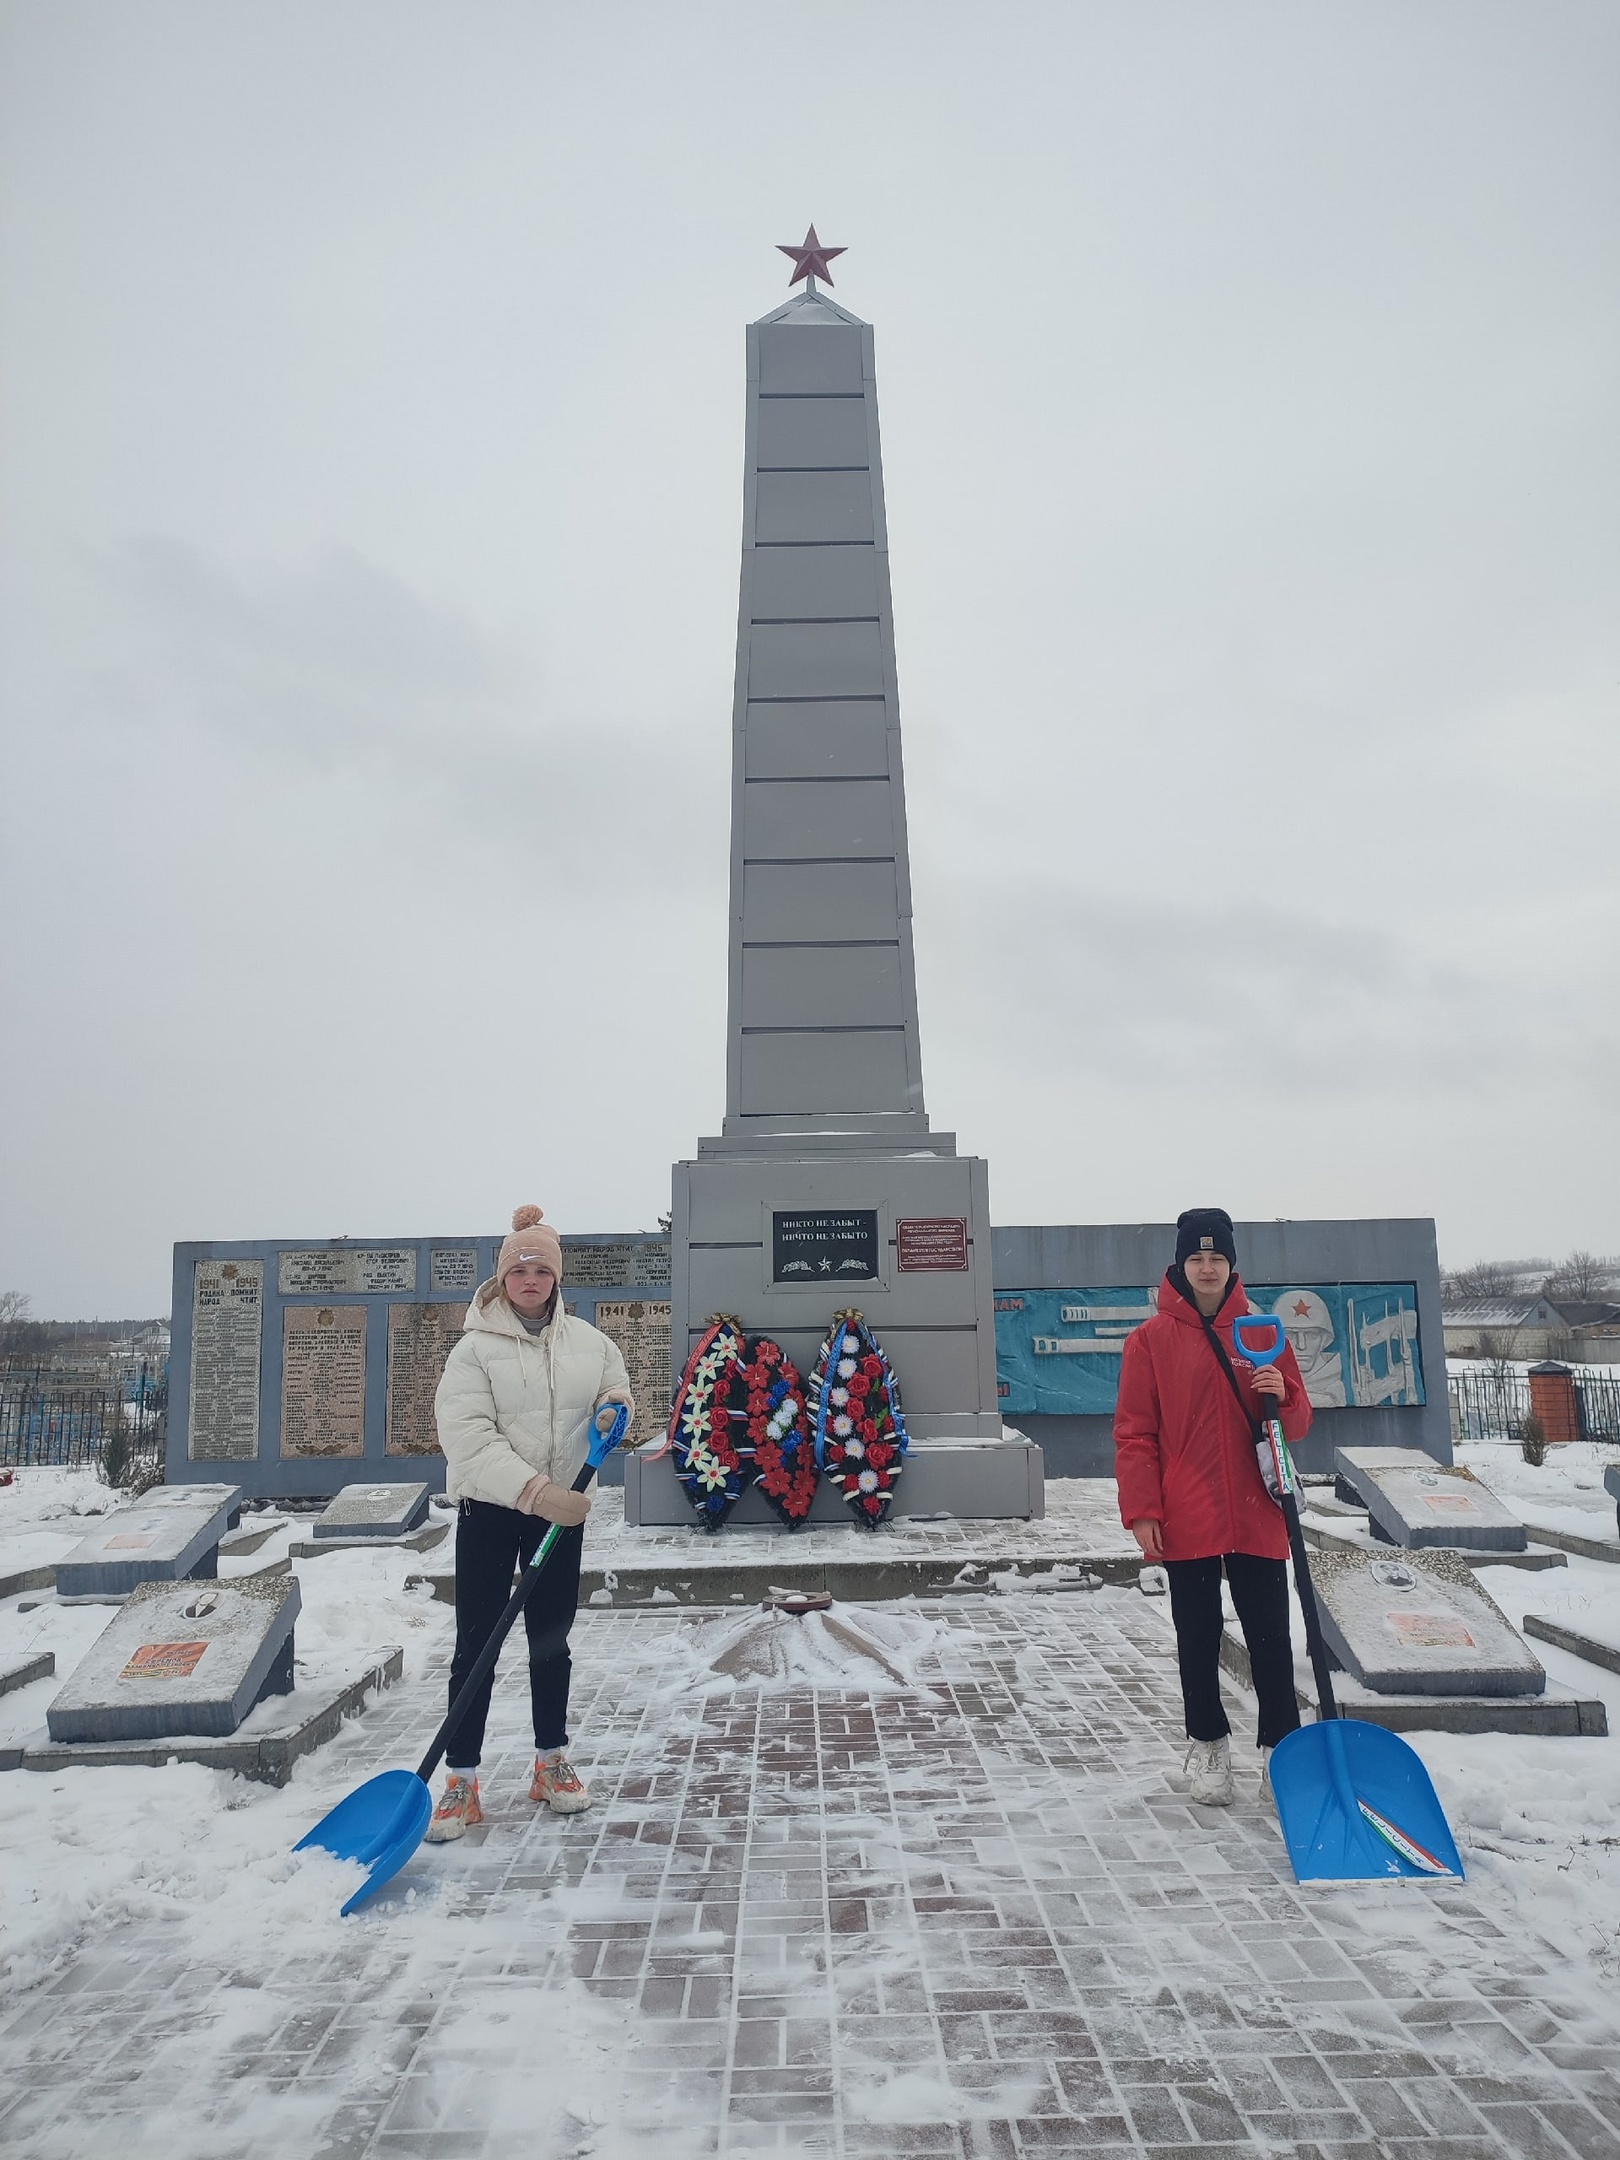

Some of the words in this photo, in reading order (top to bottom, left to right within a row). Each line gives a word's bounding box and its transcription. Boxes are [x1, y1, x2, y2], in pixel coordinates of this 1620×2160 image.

[830, 1219, 861, 1227] ЗАБЫТ
[782, 1233, 814, 1241] НИЧТО
[816, 1232, 829, 1240] НЕ
[830, 1231, 868, 1240] ЗАБЫТО
[200, 1280, 219, 1289] 1941
[235, 1278, 258, 1288] 1945
[600, 1306, 624, 1316] 1941
[649, 1305, 671, 1315] 1945
[1362, 1807, 1424, 1864] FELICITA
